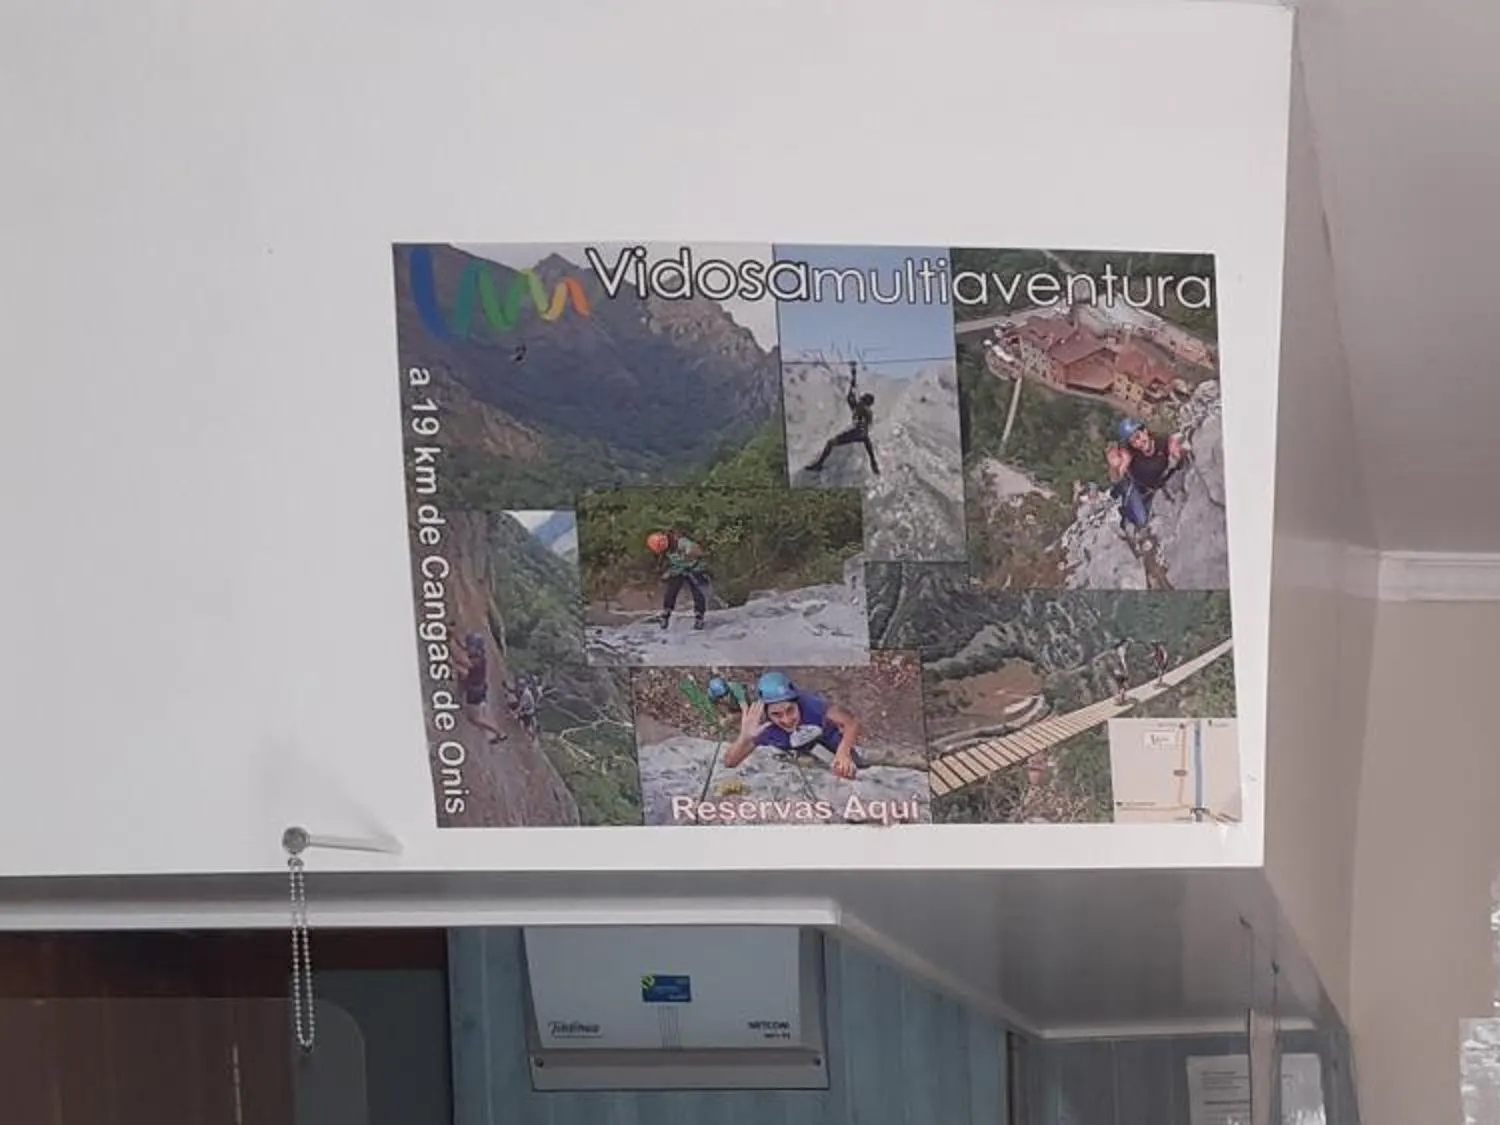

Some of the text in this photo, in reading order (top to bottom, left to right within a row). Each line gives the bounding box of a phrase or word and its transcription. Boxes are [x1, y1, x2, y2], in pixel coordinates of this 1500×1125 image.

[409, 367, 470, 814] a 19 km de Cangas de Onis
[671, 795, 834, 821] Reservas
